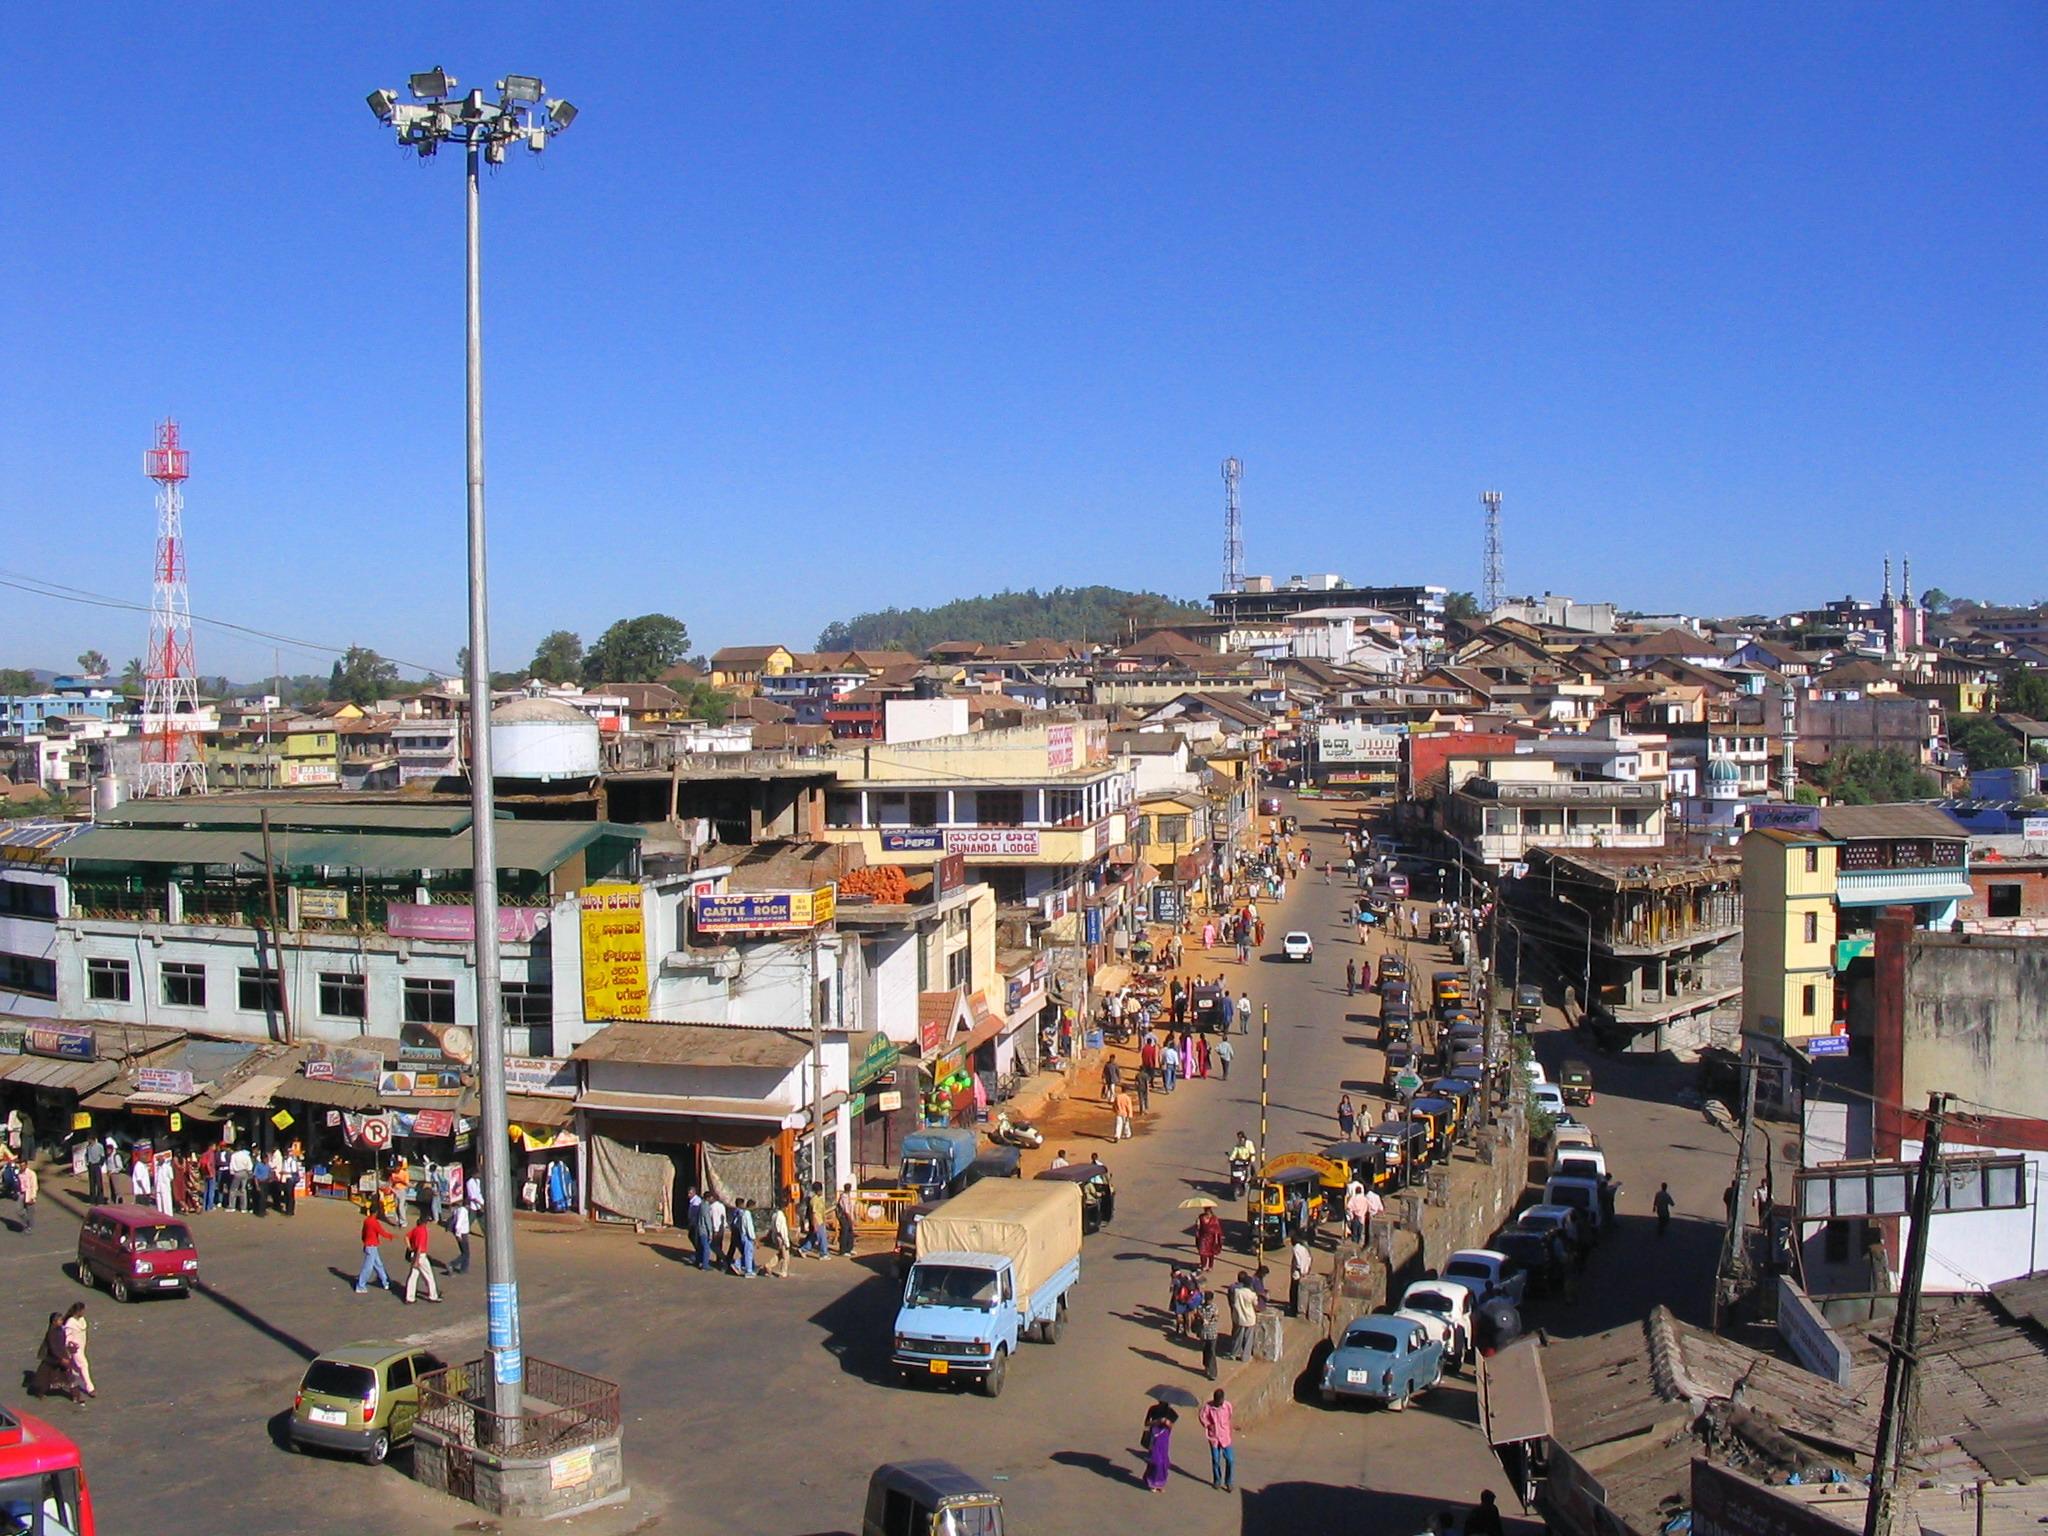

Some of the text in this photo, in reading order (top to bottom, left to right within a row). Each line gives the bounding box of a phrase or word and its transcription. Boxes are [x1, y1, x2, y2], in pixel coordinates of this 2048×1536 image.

[904, 838, 935, 848] PEPSI
[950, 843, 1037, 853] SUNANDA LODGE
[703, 906, 746, 917] CASTLE
[753, 905, 787, 915] ROCK
